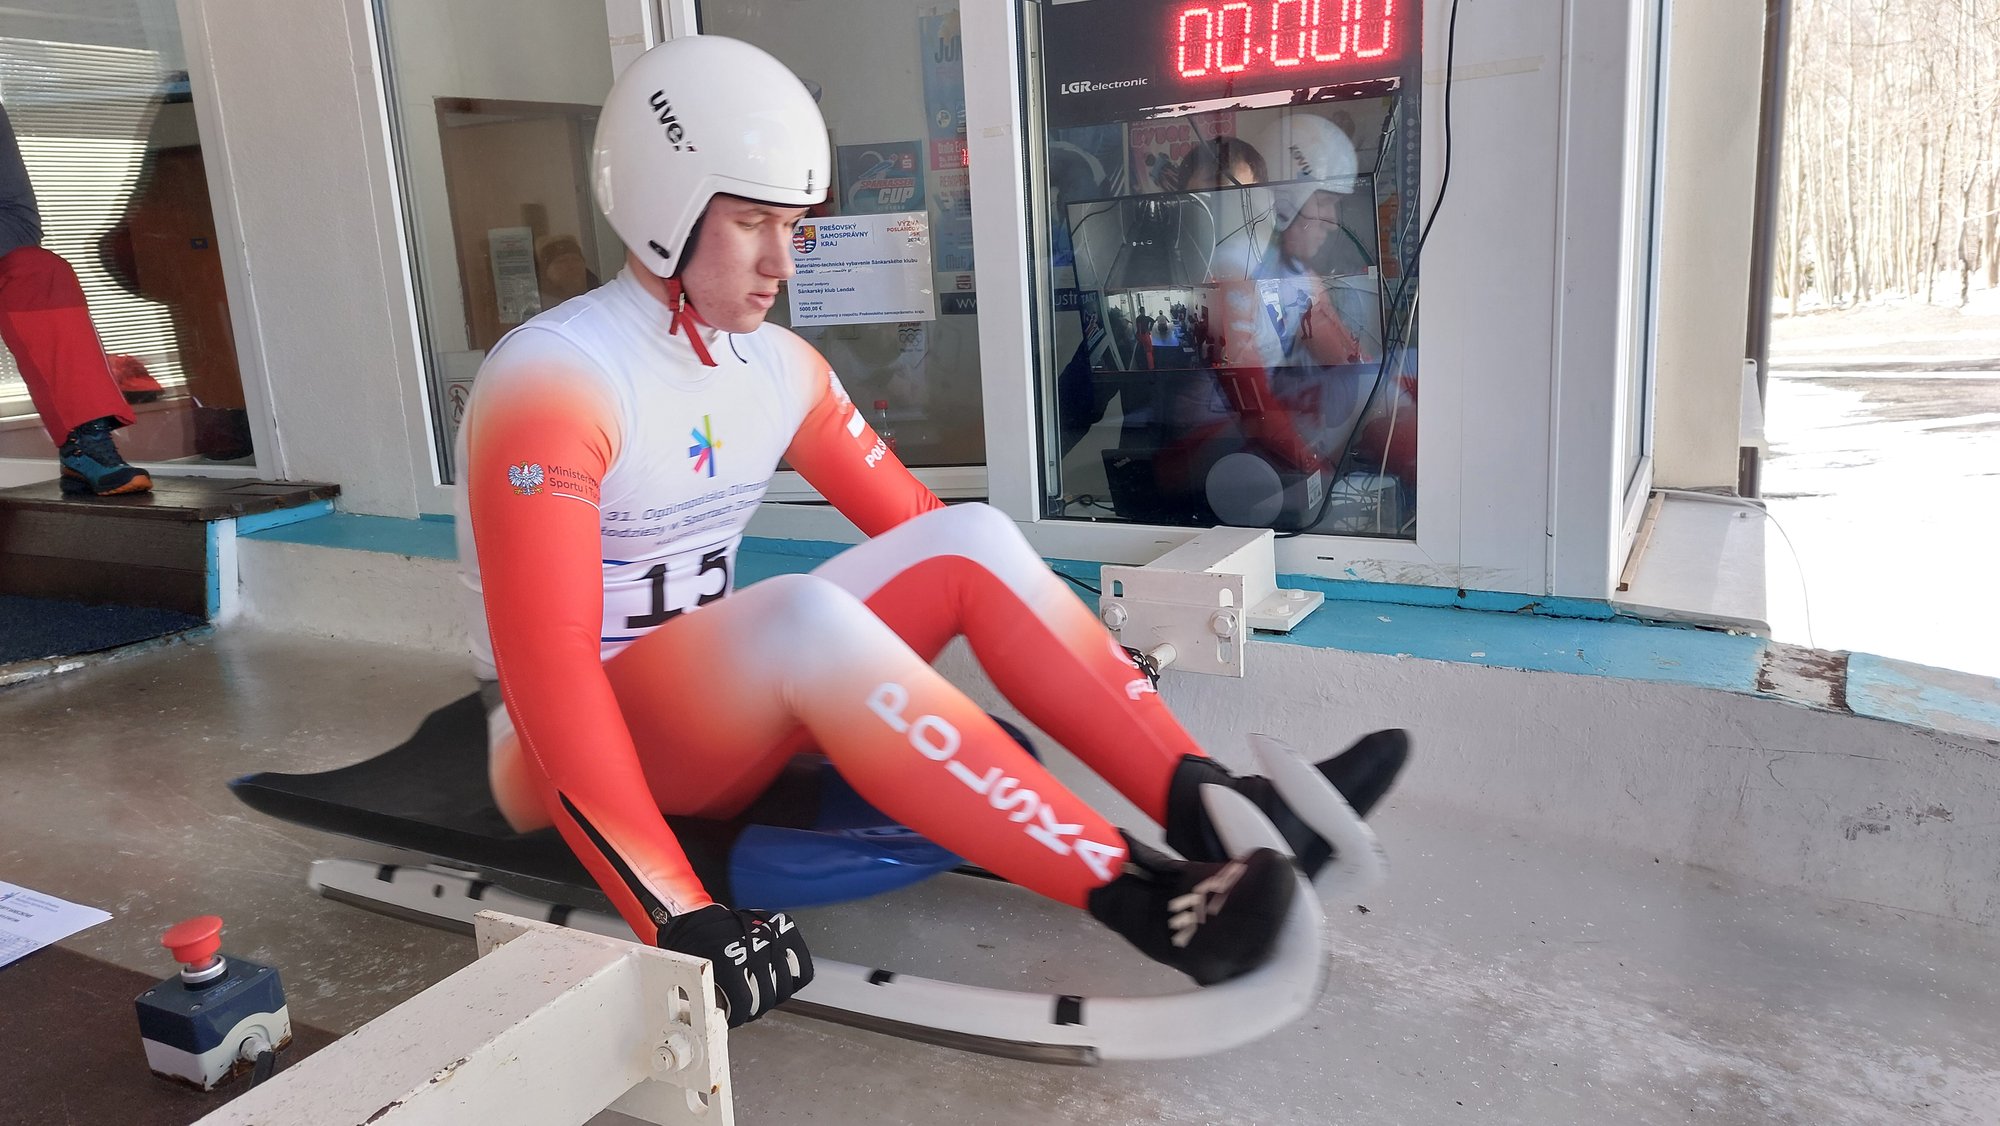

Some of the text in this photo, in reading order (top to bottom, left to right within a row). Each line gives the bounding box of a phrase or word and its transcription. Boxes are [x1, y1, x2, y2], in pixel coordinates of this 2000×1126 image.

[878, 187, 915, 205] CUP
[819, 223, 857, 232] PREŠOVSKÝ
[820, 230, 869, 240] SAMOSPRÁVNY
[820, 240, 838, 248] KRAJ
[550, 477, 584, 493] Sportu
[604, 510, 637, 522] 31.
[626, 545, 729, 629] 15
[866, 681, 1127, 882] POLSKA
